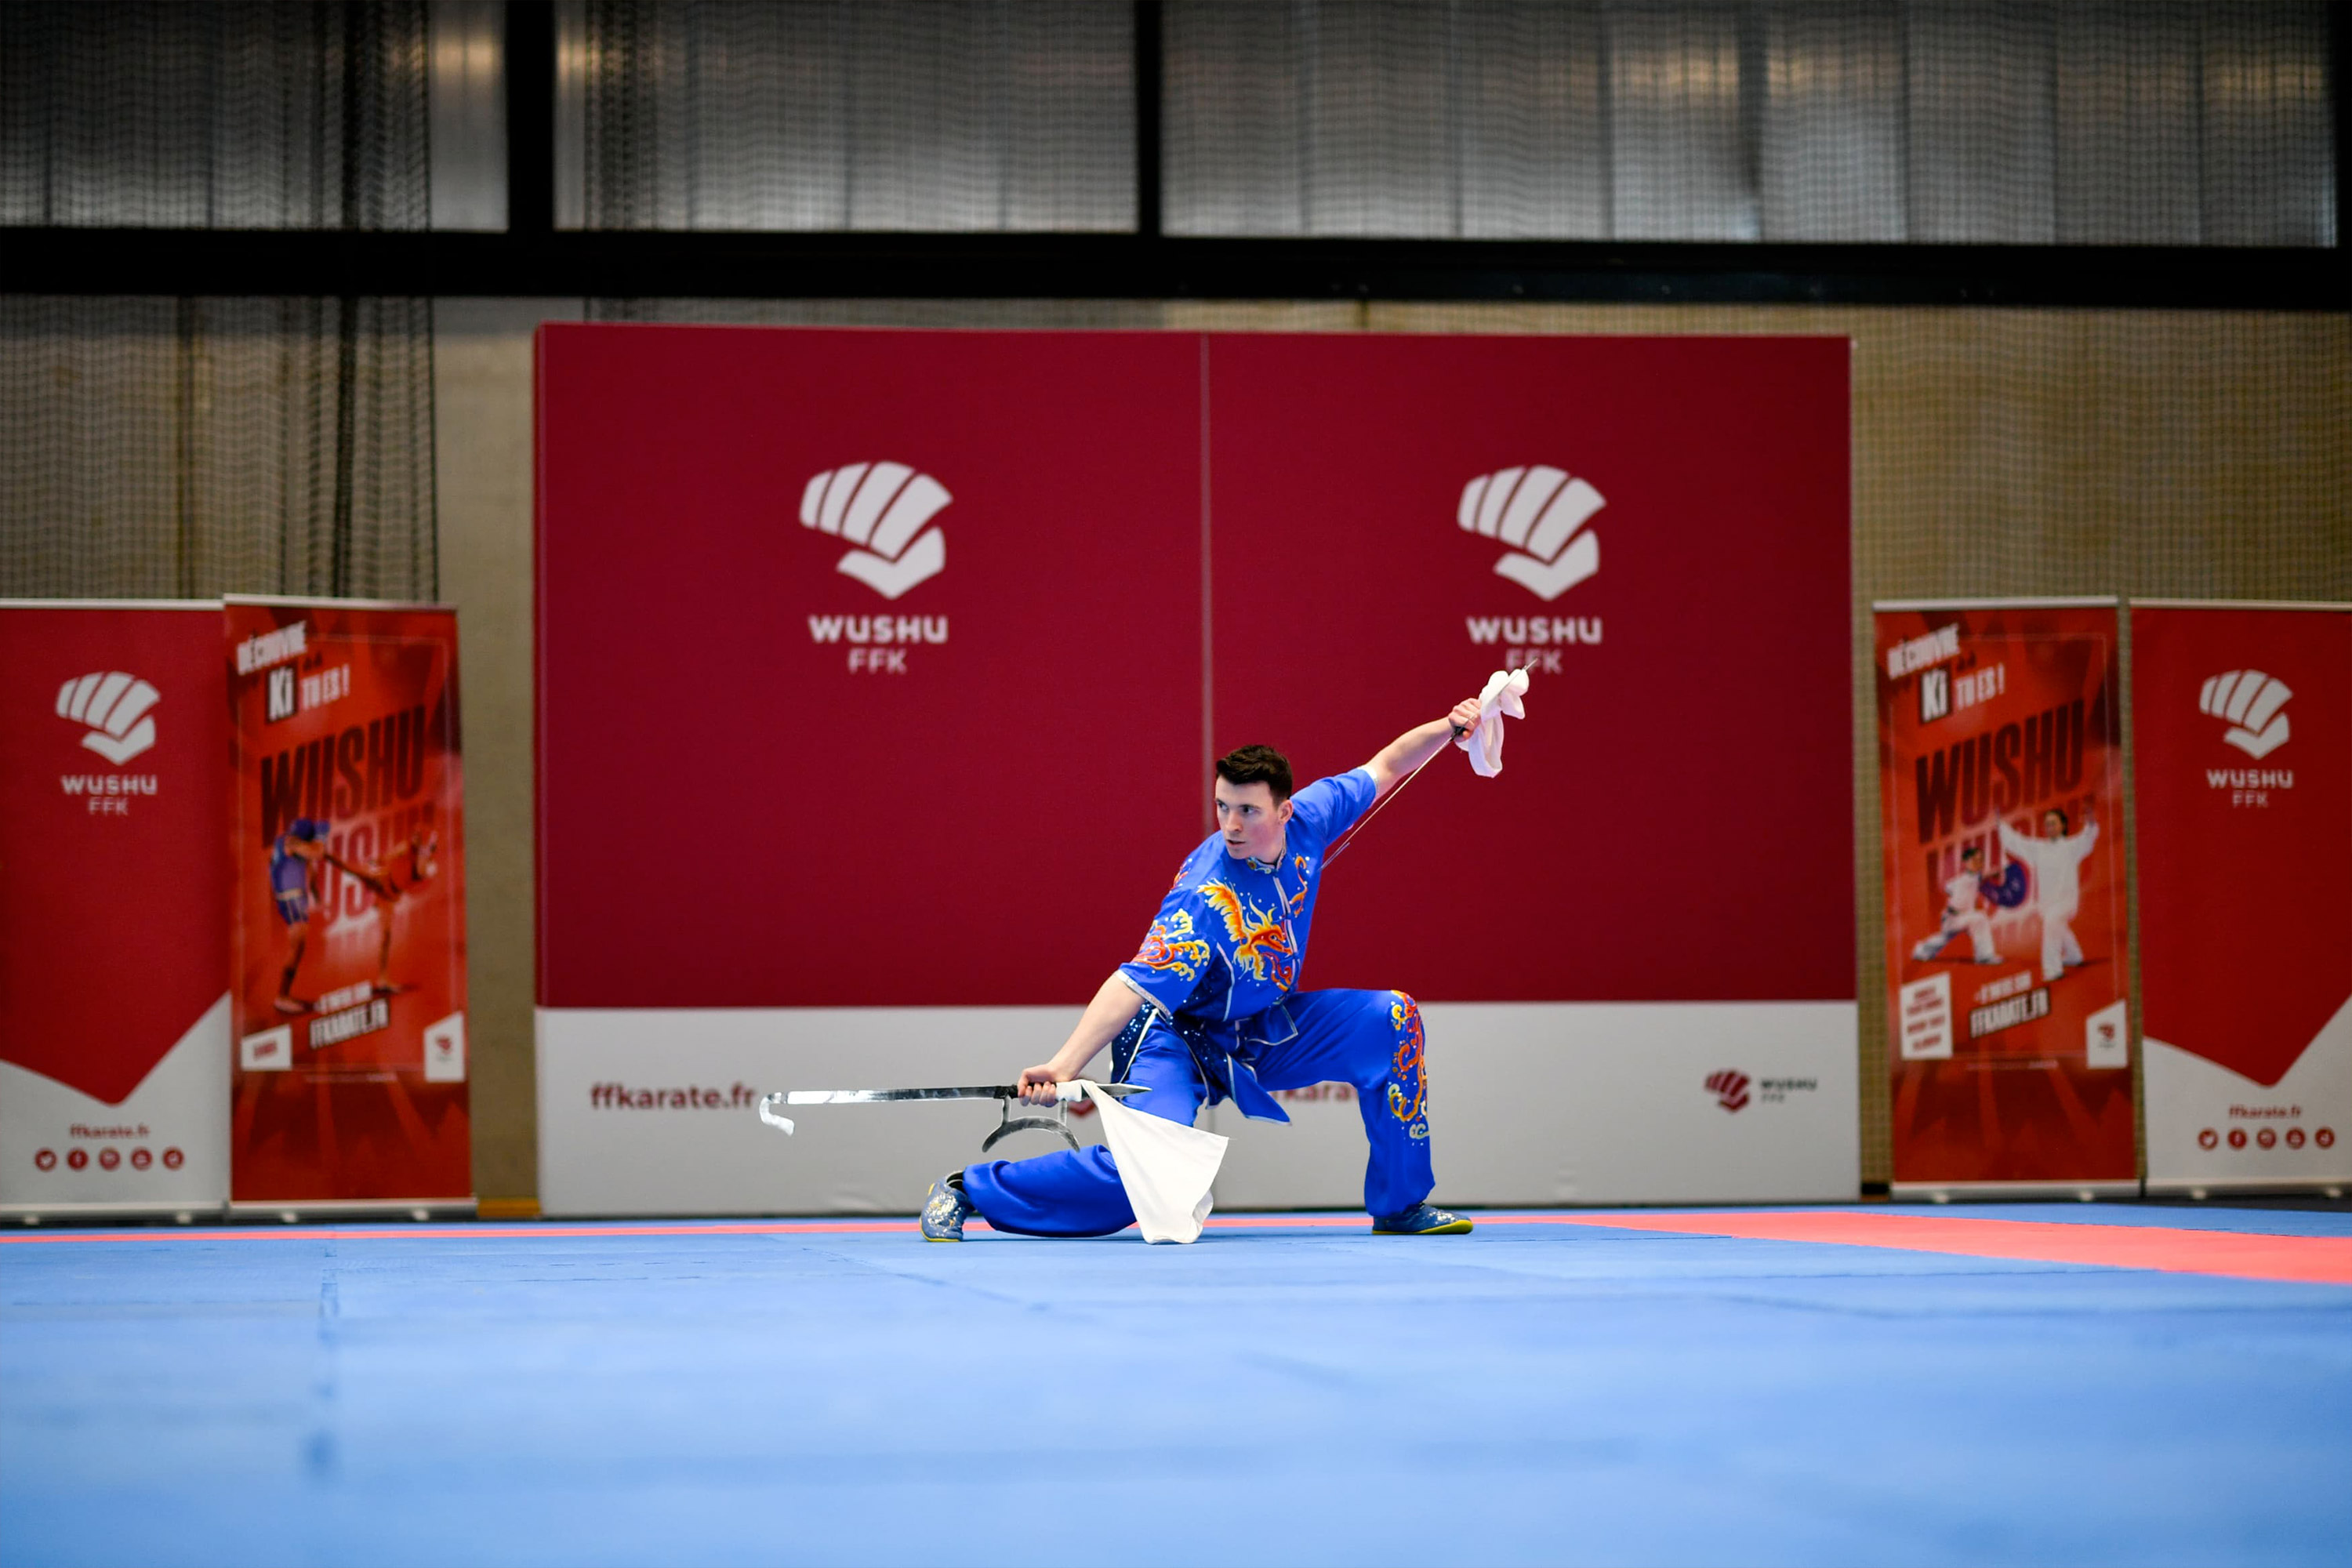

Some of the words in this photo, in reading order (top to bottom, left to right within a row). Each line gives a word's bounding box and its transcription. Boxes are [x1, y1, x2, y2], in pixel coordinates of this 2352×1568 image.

[808, 615, 949, 644] WUSHU
[1465, 615, 1603, 644] WUSHU
[848, 647, 907, 674] FFK
[1505, 648, 1564, 674] FFK
[61, 774, 158, 796] WUSHU
[261, 706, 426, 848] WUSHU
[1916, 698, 2085, 846] WUSHU
[2206, 769, 2294, 789] WUSHU
[88, 797, 129, 815] FFK
[2232, 790, 2269, 808] FFK
[590, 1081, 755, 1110] ffkarate.fr
[2229, 1104, 2301, 1118] ffkarate.fr
